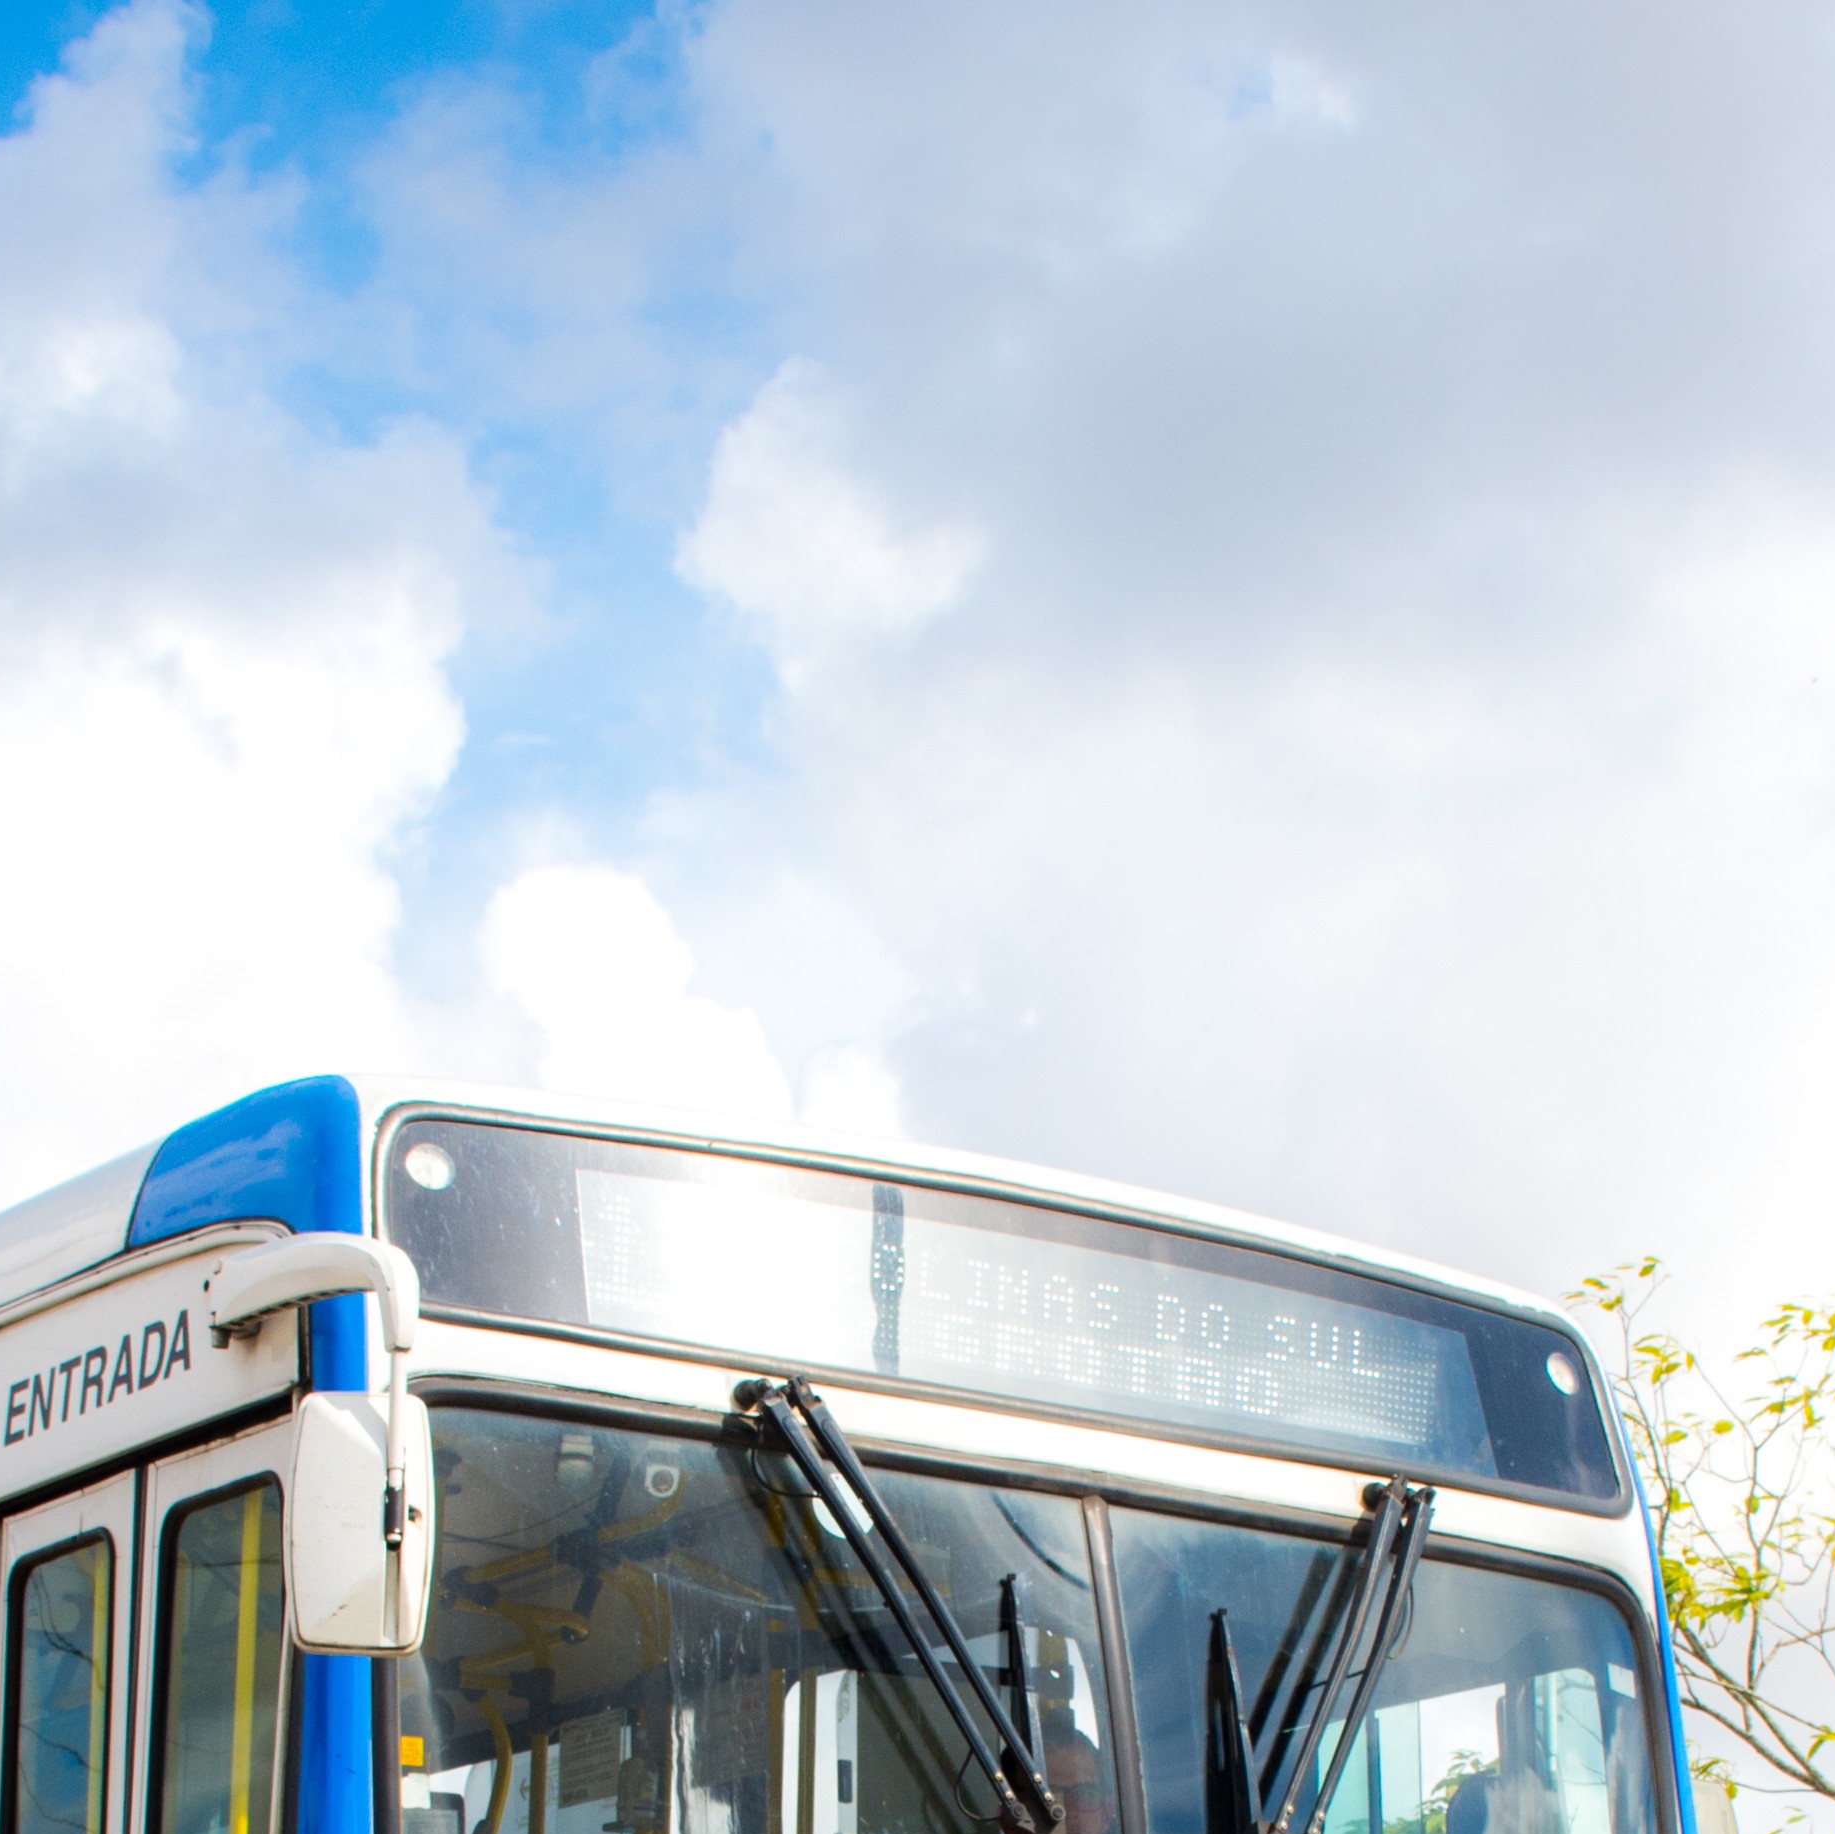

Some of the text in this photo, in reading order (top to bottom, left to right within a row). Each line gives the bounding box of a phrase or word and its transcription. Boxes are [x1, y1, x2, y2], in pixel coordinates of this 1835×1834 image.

[3, 1309, 191, 1447] ENTRADA
[872, 1244, 1120, 1331] OLINAS
[1156, 1292, 1230, 1350] DO
[1265, 1315, 1382, 1379] SUL
